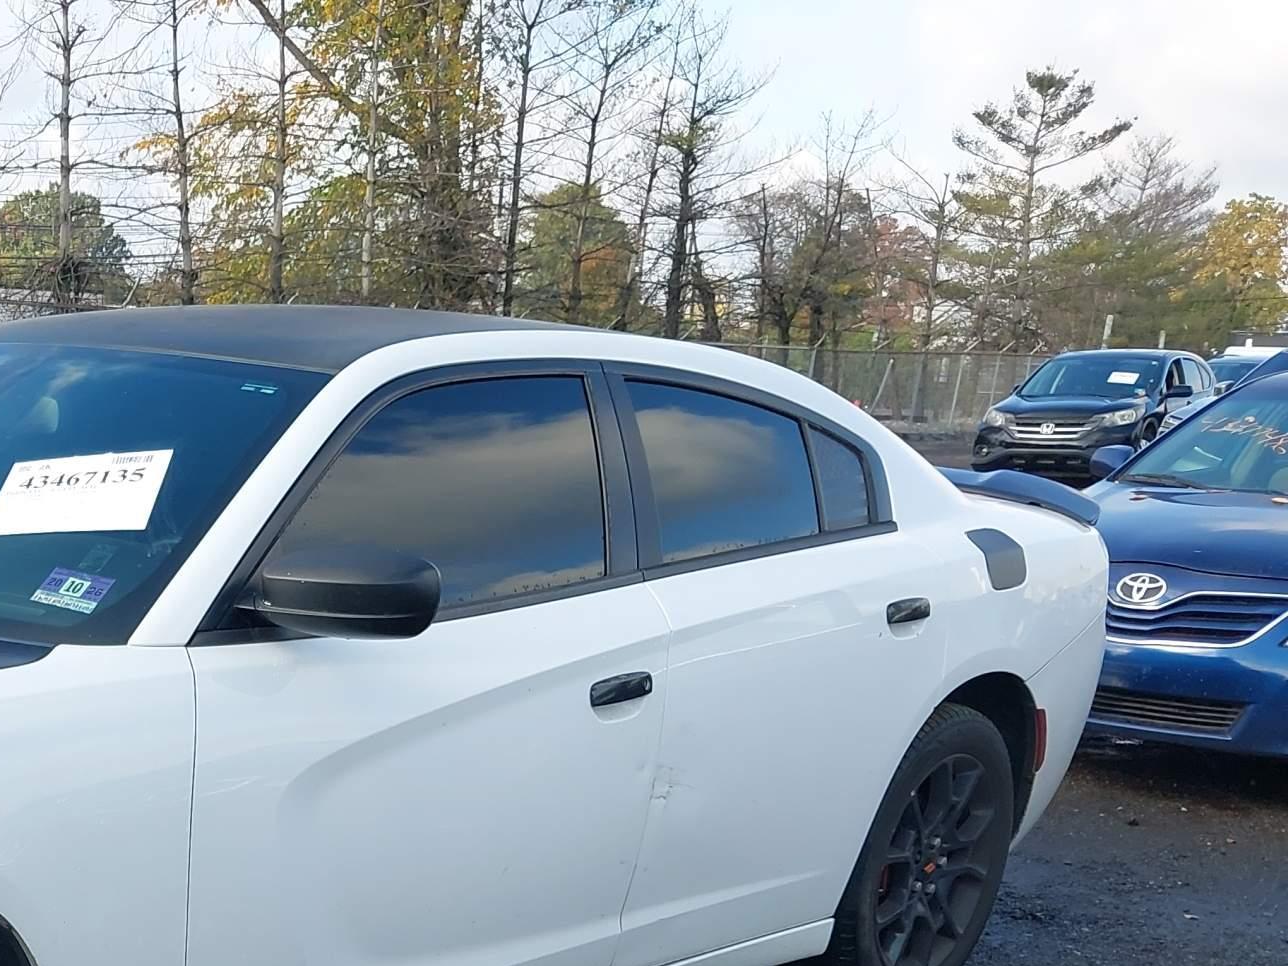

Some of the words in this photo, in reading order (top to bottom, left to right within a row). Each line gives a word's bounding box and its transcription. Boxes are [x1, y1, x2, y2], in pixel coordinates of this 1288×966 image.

[19, 467, 147, 489] 43467135
[47, 578, 64, 587] 20
[63, 580, 85, 594] 10
